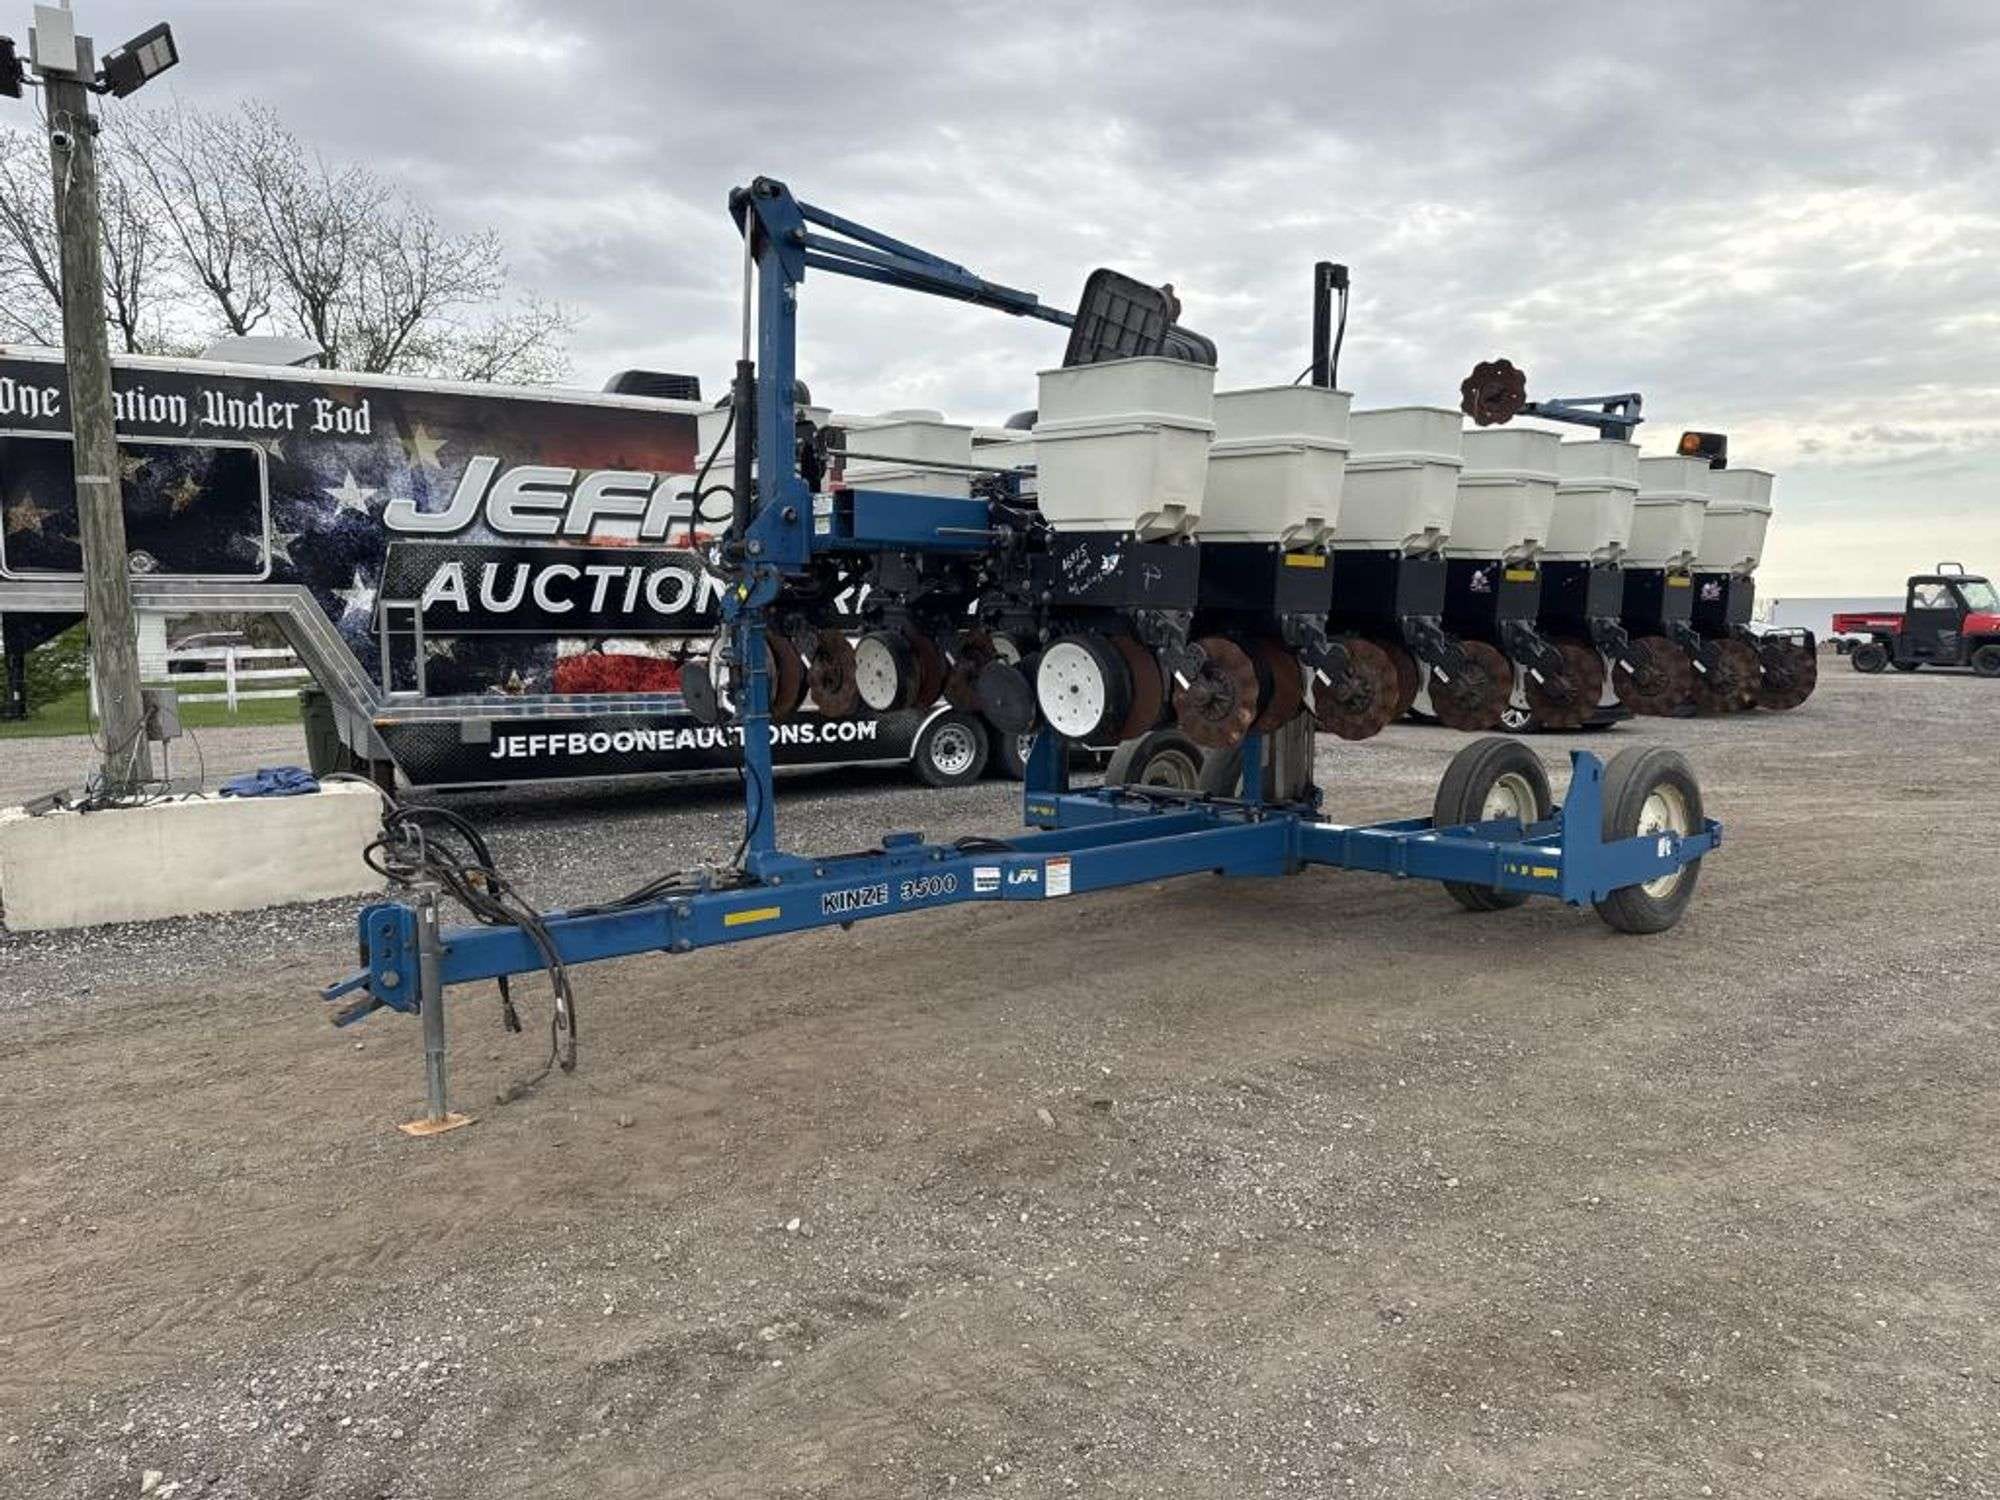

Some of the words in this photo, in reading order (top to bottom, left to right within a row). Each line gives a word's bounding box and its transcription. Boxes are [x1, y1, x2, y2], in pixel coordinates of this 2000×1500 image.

[111, 386, 188, 428] ation
[201, 390, 299, 431] Under
[311, 398, 372, 435] God
[822, 883, 888, 916] KINZE
[900, 873, 957, 900] 3500
